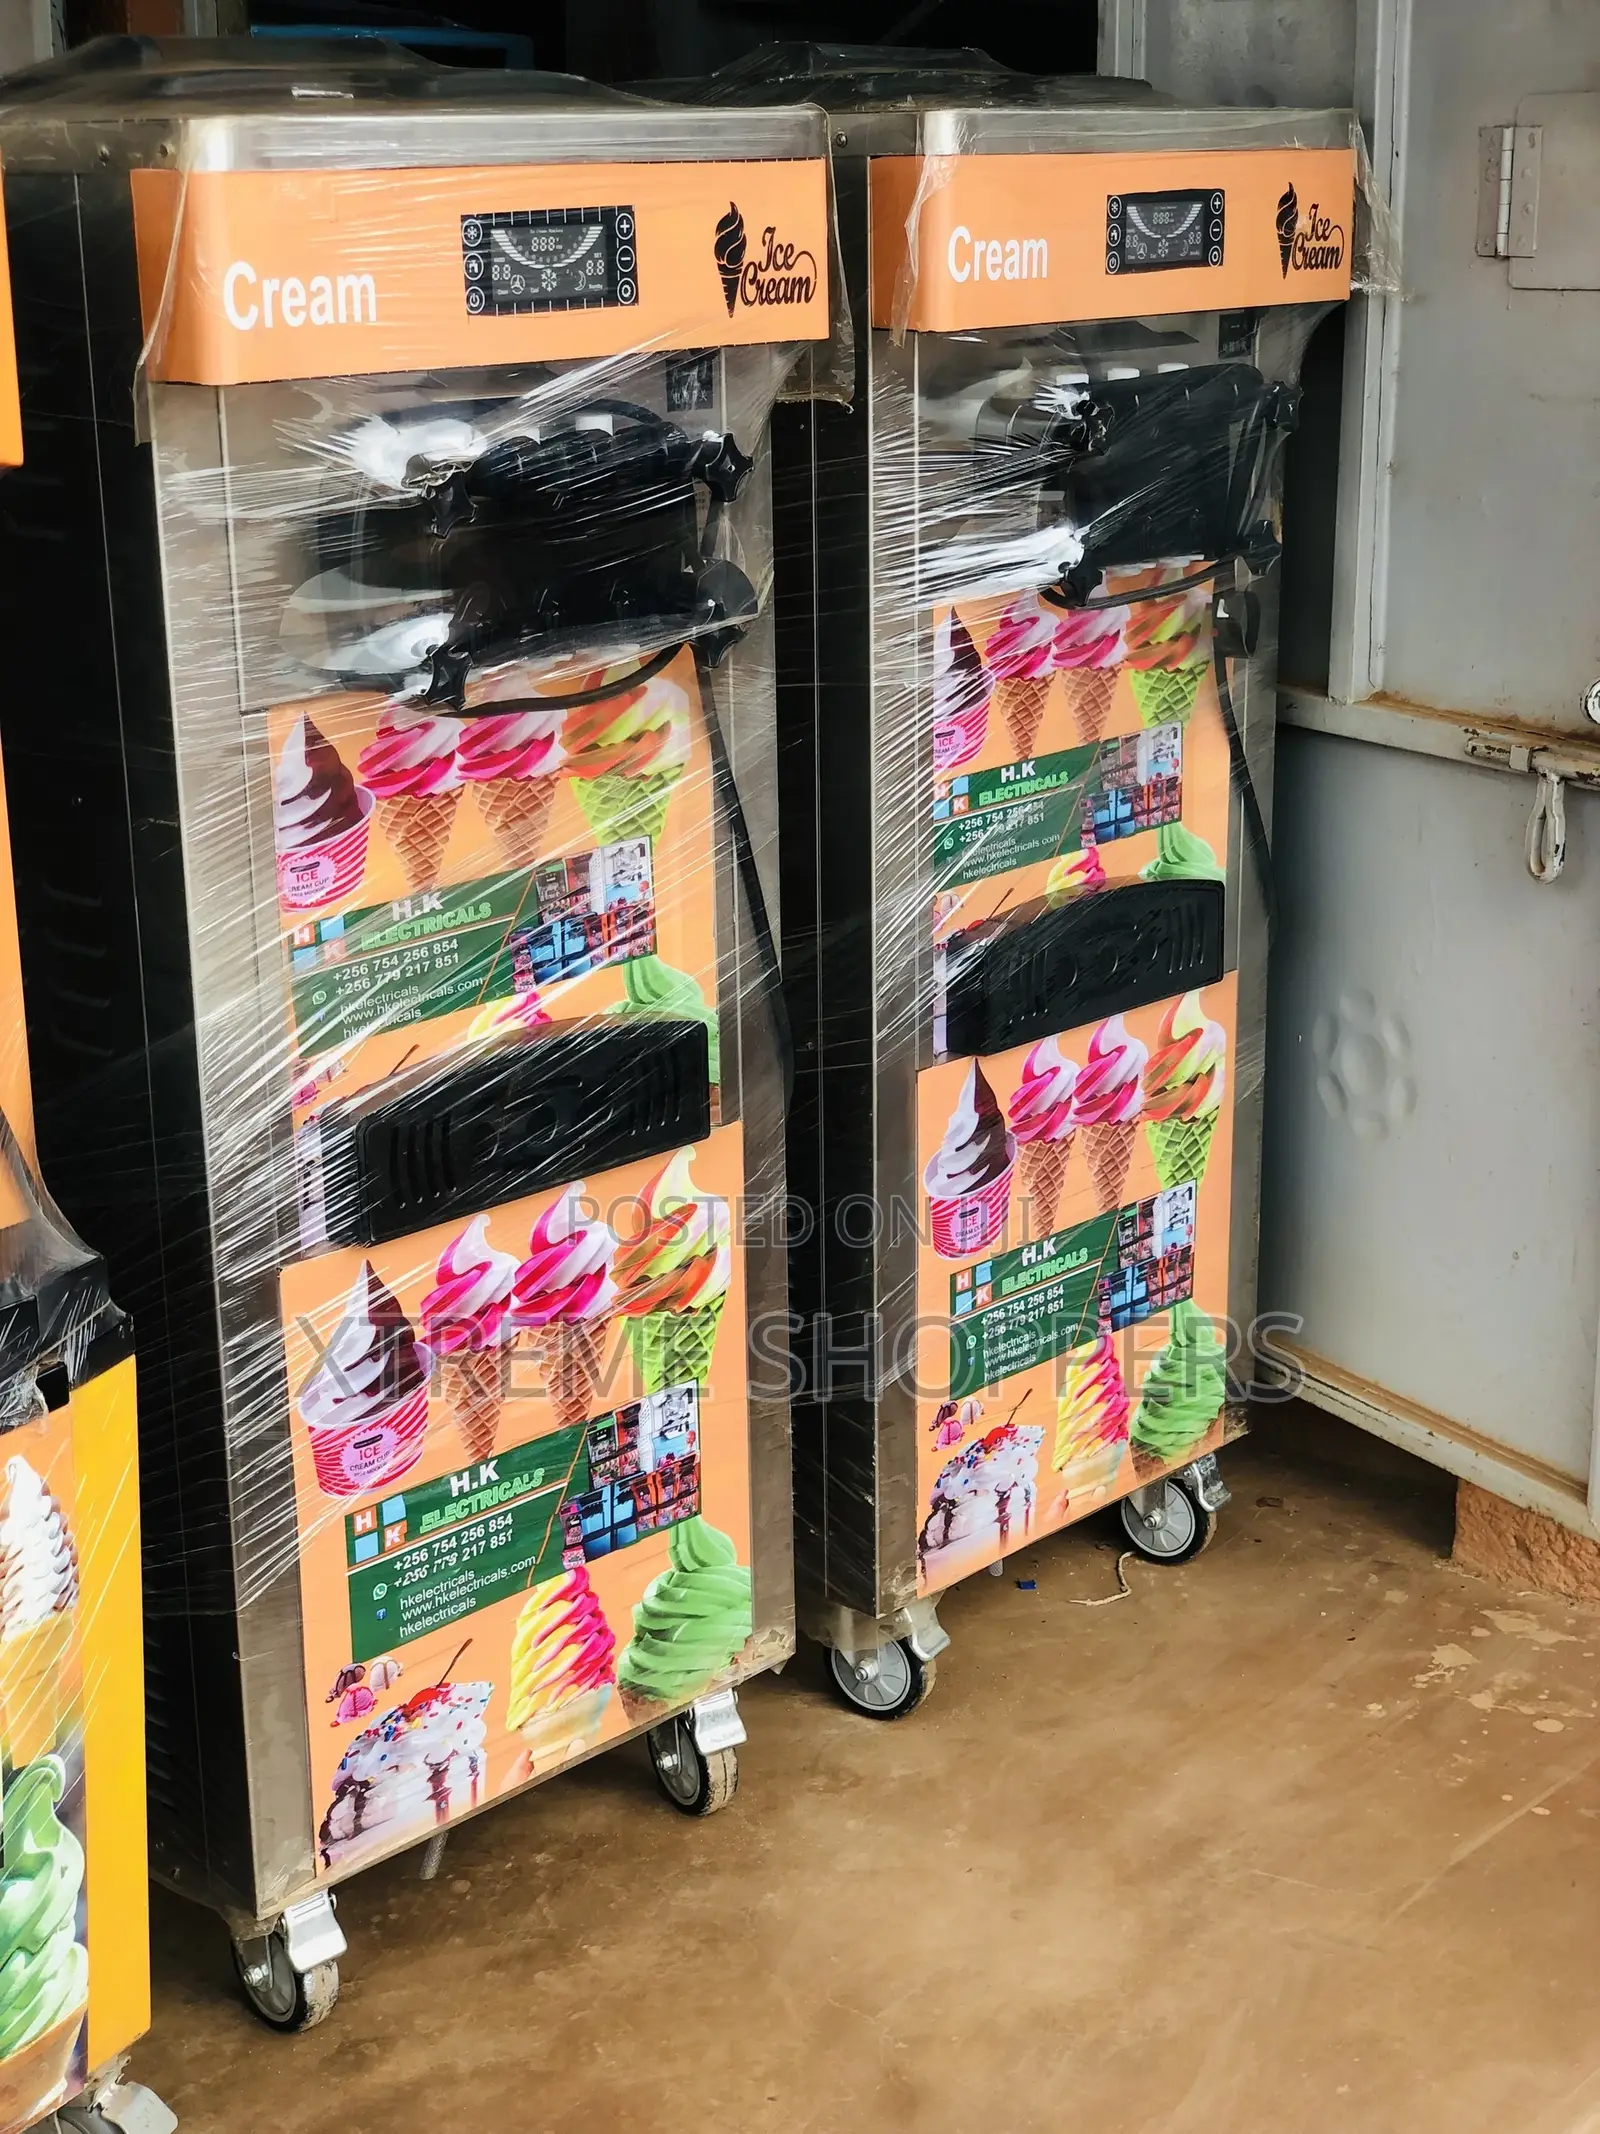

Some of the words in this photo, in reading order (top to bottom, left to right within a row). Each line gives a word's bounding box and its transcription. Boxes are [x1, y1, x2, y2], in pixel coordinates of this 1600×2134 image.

[1305, 203, 1331, 242] Ice
[758, 226, 797, 272] Ice
[948, 226, 1048, 283] Cream
[1292, 231, 1342, 270] Cream
[223, 260, 377, 330] Cream
[740, 261, 814, 307] Cream
[938, 736, 954, 747] ICE
[979, 771, 1069, 806] ELECTRICALS
[1001, 760, 1036, 783] H.K
[953, 797, 966, 812] K
[958, 816, 983, 831] +256
[986, 811, 1004, 824] 754
[959, 828, 984, 844] +256
[1028, 812, 1044, 826] 851
[296, 869, 318, 883] ICE
[391, 891, 444, 922] H.K
[294, 928, 310, 945] H
[360, 902, 492, 951] ELECTRICALS
[333, 963, 369, 982] +256
[372, 956, 400, 972] 754
[403, 946, 429, 964] 256
[433, 938, 459, 954] 854
[336, 977, 372, 996] +256
[406, 960, 430, 978] 217
[435, 952, 460, 969] 851
[1022, 1236, 1057, 1266] H.K
[957, 1274, 968, 1291] H
[1002, 1248, 1088, 1296] ELECTRICALS
[976, 1285, 988, 1305] K
[981, 1308, 1005, 1326] +256
[1008, 1300, 1026, 1314] 754
[1028, 1293, 1044, 1308] 256
[1046, 1284, 1064, 1298] 854
[982, 1324, 1006, 1340] +256
[1008, 1316, 1026, 1330] 779
[1028, 1307, 1045, 1322] 217
[1047, 1298, 1064, 1314] 851
[982, 1330, 1036, 1359] hkelectricals
[984, 1322, 1078, 1369] www.hkelectricals.com
[984, 1353, 1036, 1382] hkelectricals
[350, 1460, 375, 1472] CREAM
[360, 1445, 381, 1460] ICE
[450, 1459, 500, 1498] H.K
[420, 1468, 545, 1534] ELECTRICALS
[355, 1511, 372, 1532] H
[385, 1524, 402, 1546] K
[394, 1552, 429, 1571] +256
[433, 1540, 458, 1557] 754
[460, 1528, 485, 1545] 256
[488, 1512, 514, 1528] 854
[462, 1540, 486, 1562] 217
[490, 1529, 514, 1549] 851
[400, 1569, 476, 1610] hkelectricals
[402, 1555, 536, 1622] www.hkelectricals.com
[400, 1596, 476, 1638] hkelectricals
